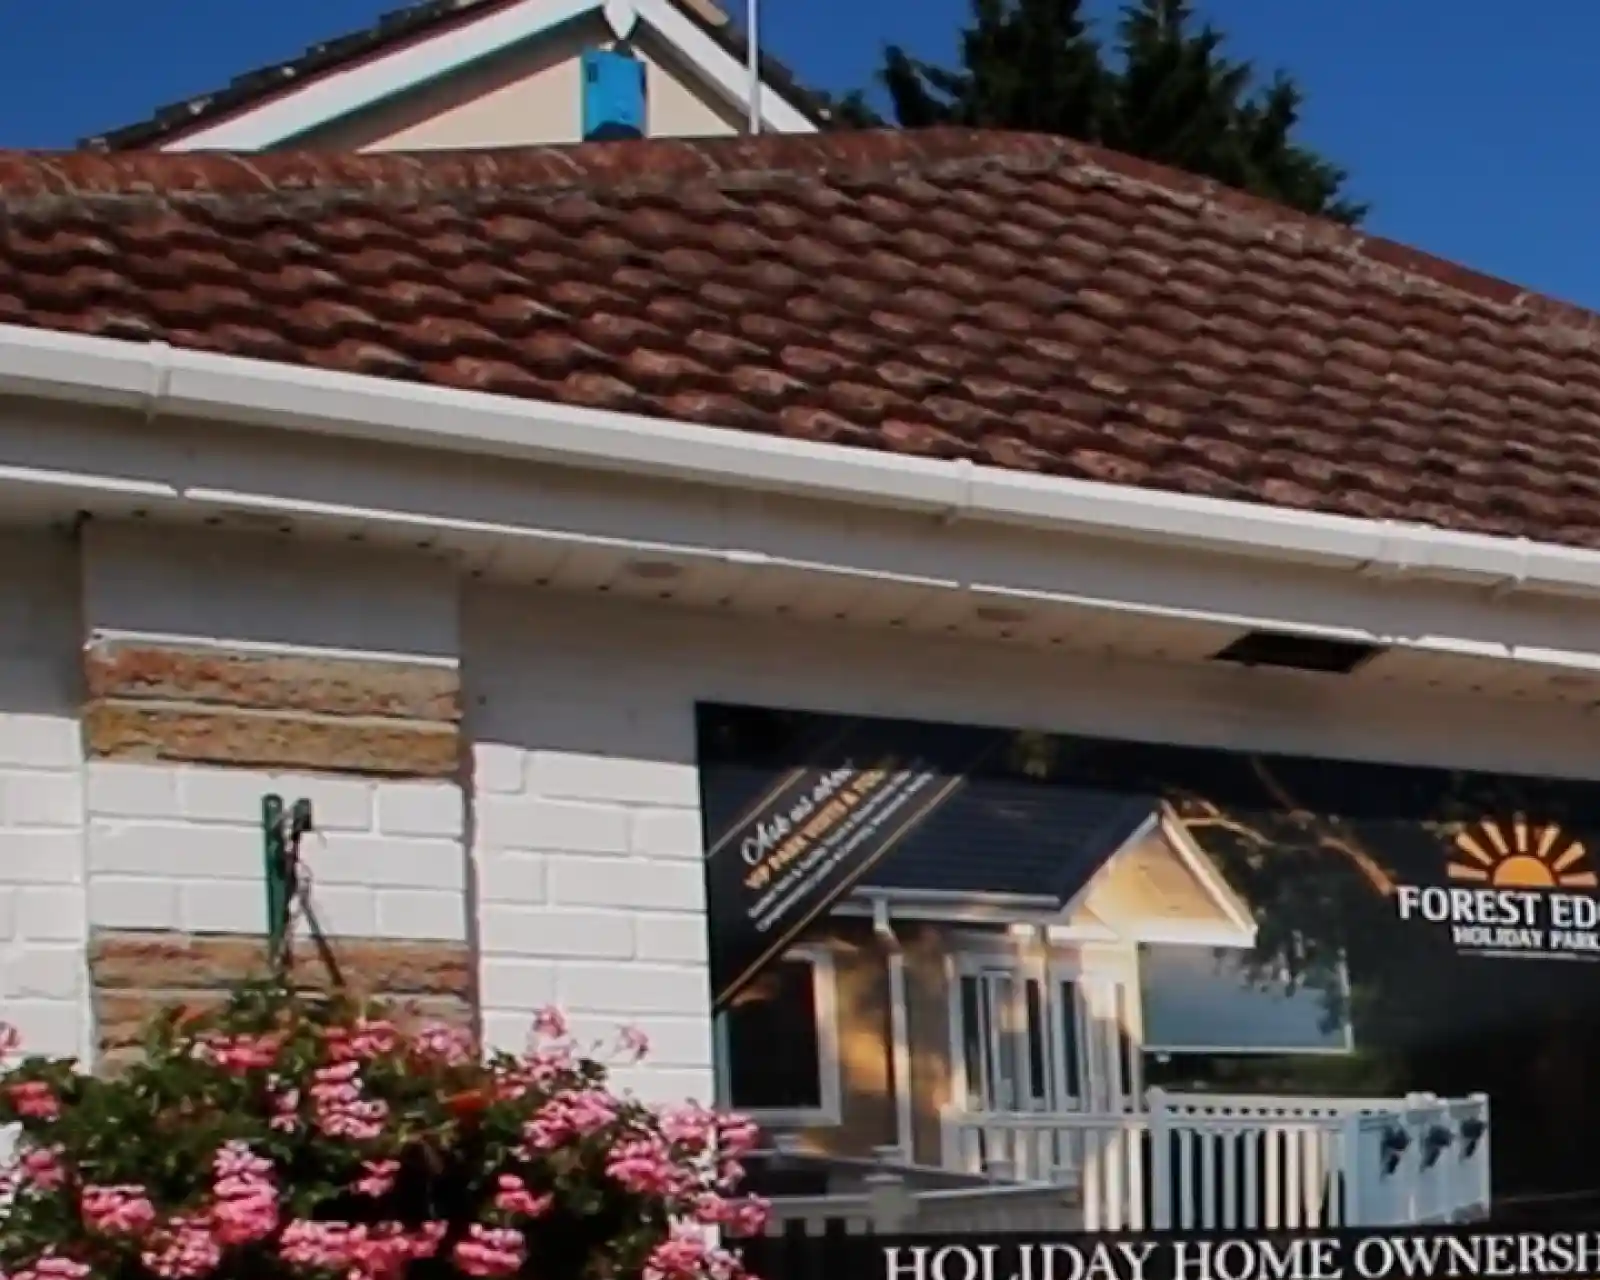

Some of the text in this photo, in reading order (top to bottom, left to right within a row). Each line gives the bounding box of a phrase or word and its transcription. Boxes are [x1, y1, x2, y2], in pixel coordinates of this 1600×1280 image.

[1396, 885, 1542, 926] FOREST
[1452, 925, 1600, 951] HOLIDAY PARK
